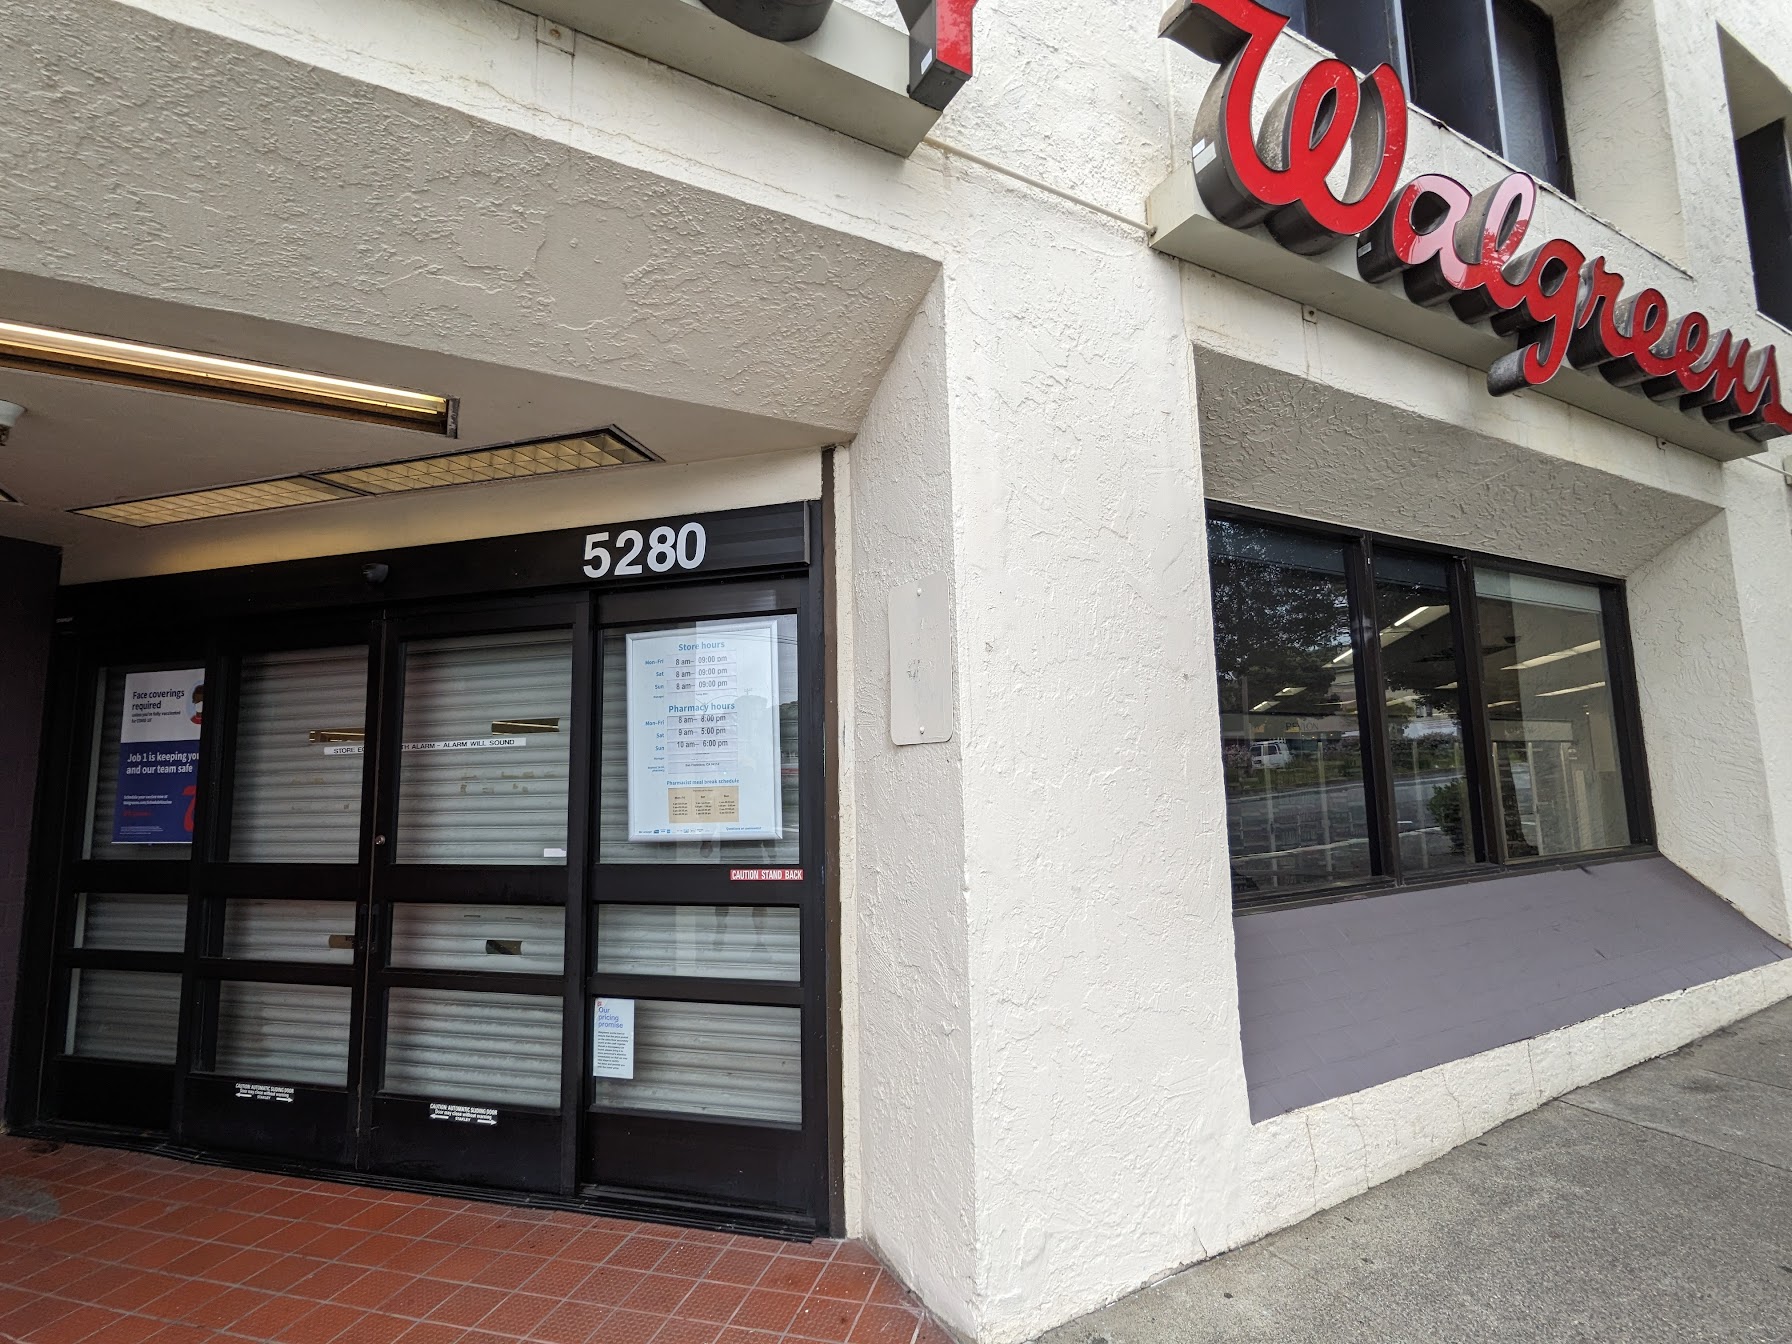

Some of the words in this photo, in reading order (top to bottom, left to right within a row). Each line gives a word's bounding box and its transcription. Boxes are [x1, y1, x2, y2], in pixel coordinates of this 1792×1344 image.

[1190, 0, 1792, 432] Walgreens
[583, 522, 706, 578] 5280
[678, 643, 699, 651] Store
[701, 641, 725, 650] hours
[698, 668, 716, 676] 09:00
[717, 680, 728, 688] pm
[132, 691, 148, 700] Face
[148, 688, 185, 700] coverings
[131, 700, 162, 712] required
[668, 704, 709, 713] Pharmacy
[710, 702, 735, 711] hours
[715, 715, 726, 723] pm
[700, 727, 715, 735] 5:00
[715, 727, 726, 735] pm
[702, 739, 717, 747] 6:00
[717, 740, 729, 748] pm
[127, 753, 141, 762] Job
[142, 753, 147, 762] 1
[148, 752, 156, 762] is
[156, 751, 187, 763] keeping
[126, 765, 141, 774] and
[142, 766, 157, 774] our
[157, 765, 176, 774] team
[177, 763, 193, 773] safe
[731, 869, 759, 880] CAUTION
[761, 869, 782, 880] STAND
[785, 869, 802, 880] BACK
[598, 1006, 610, 1014] Our
[598, 1014, 619, 1023] pricing
[597, 1021, 624, 1029] promise
[448, 1105, 471, 1113] AUTOMATIC
